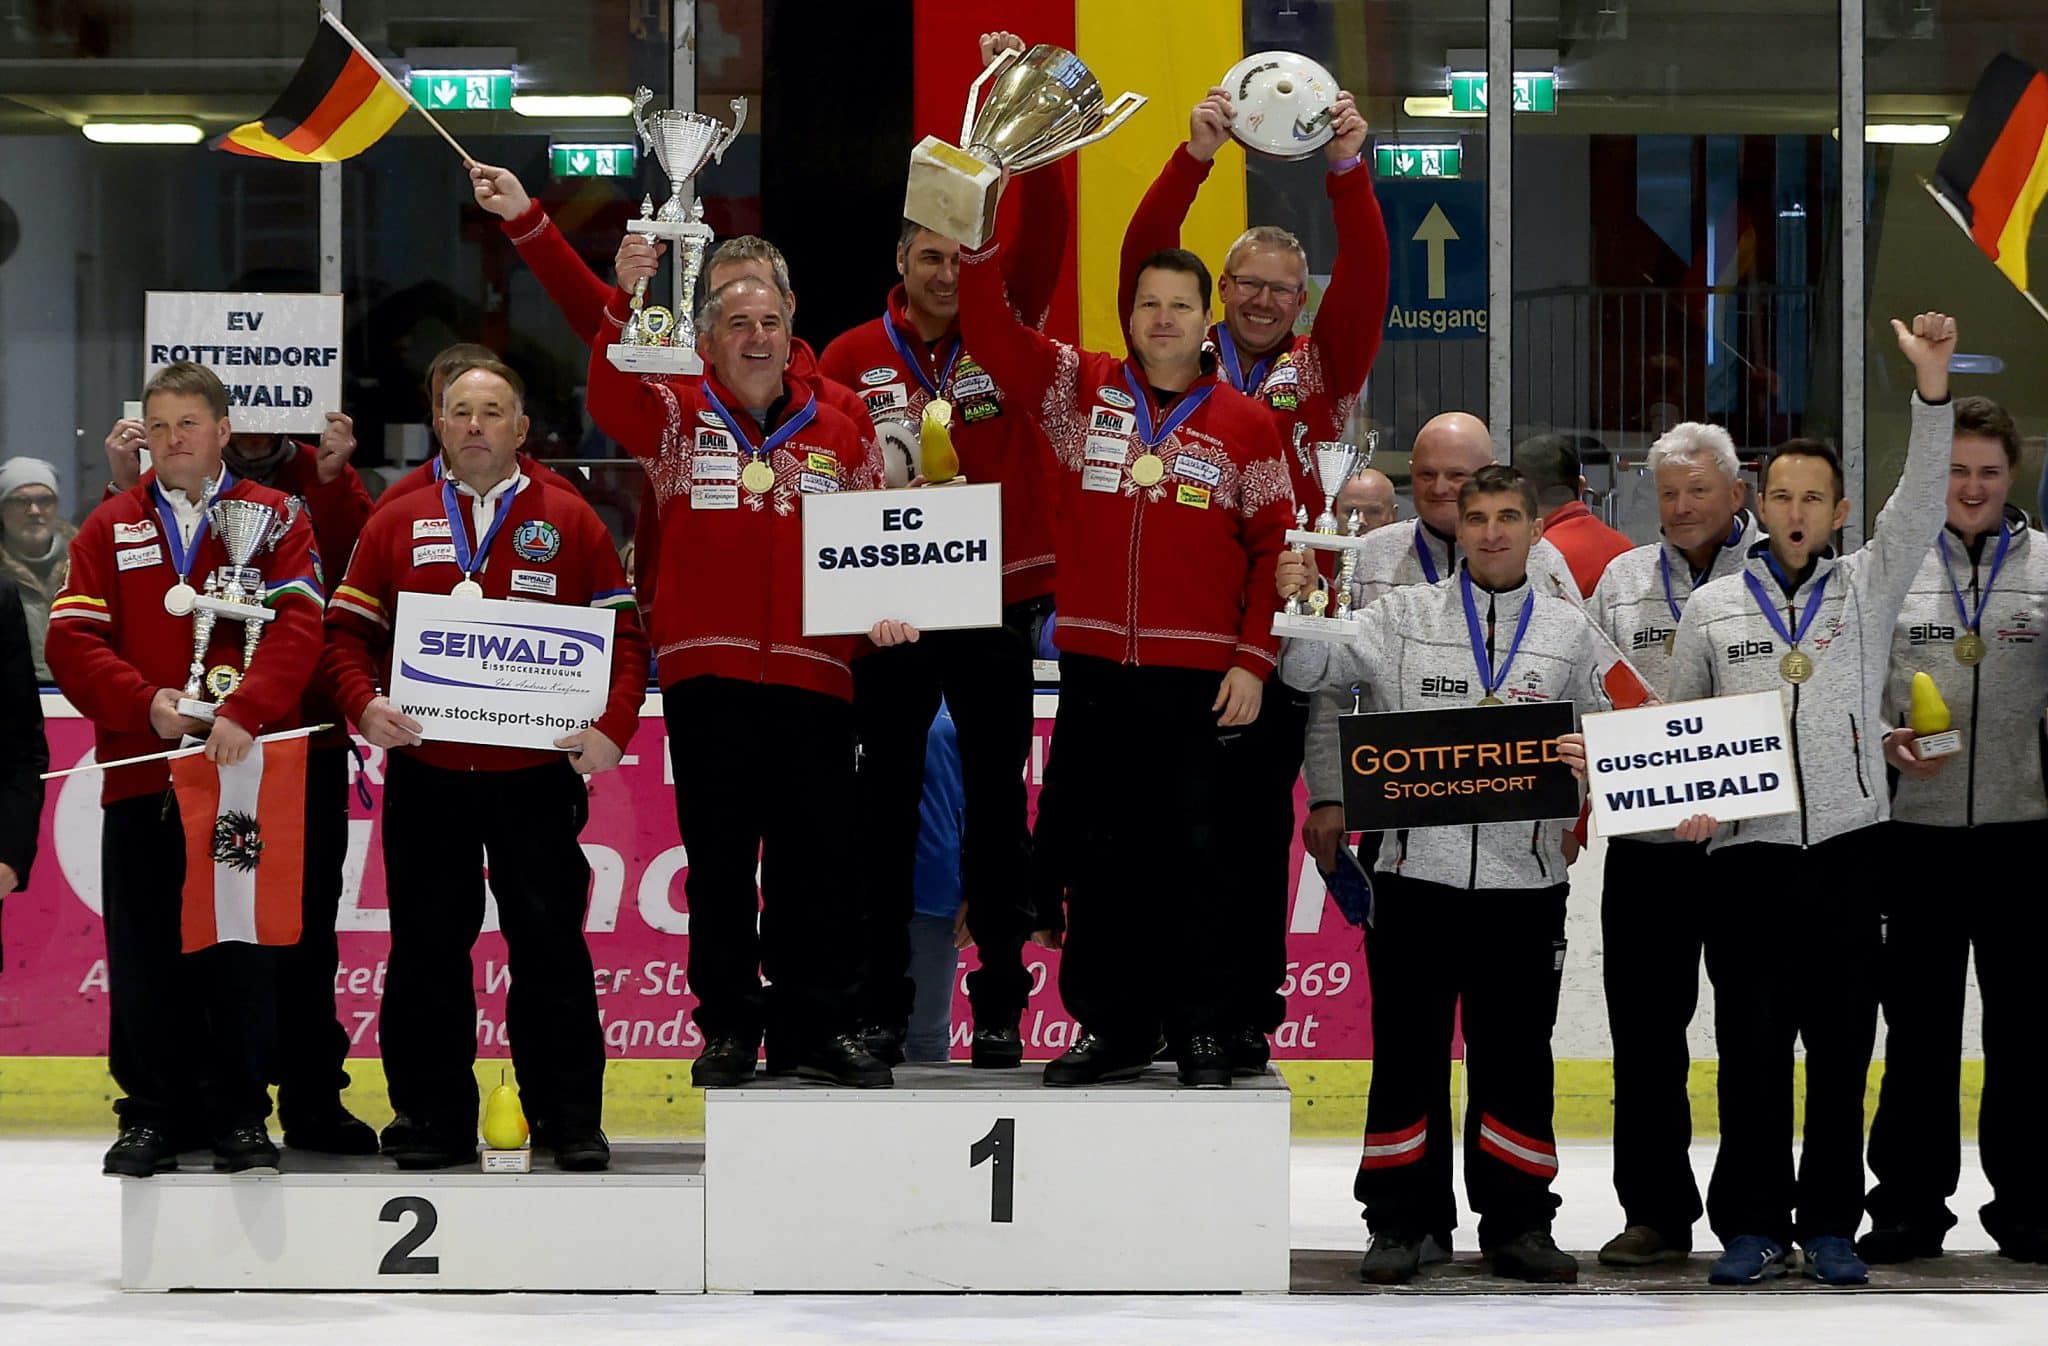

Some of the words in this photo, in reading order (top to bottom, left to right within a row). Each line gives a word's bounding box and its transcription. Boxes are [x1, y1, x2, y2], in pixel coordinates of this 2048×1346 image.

[227, 311, 264, 331] EV
[1388, 304, 1487, 333] Ausgang
[151, 344, 338, 367] ROTTENDORF
[224, 385, 313, 408] WALD
[882, 508, 924, 531] EC
[818, 539, 987, 570] SASSBACH
[1910, 623, 1955, 640] siba
[419, 630, 585, 667] SEIWALD
[1727, 640, 1773, 659] siba
[1421, 676, 1468, 694] siba
[401, 704, 597, 731] www.stocksport-shop.at
[1666, 716, 1704, 737] SU
[1351, 740, 1562, 776] GOTTFRIED
[1596, 736, 1782, 773] GUSCHLBAUER
[1383, 776, 1537, 799] STOCKSPORT
[1606, 772, 1780, 811] WILLIBALD
[970, 1118, 1015, 1223] 1
[378, 1196, 439, 1274] 2
